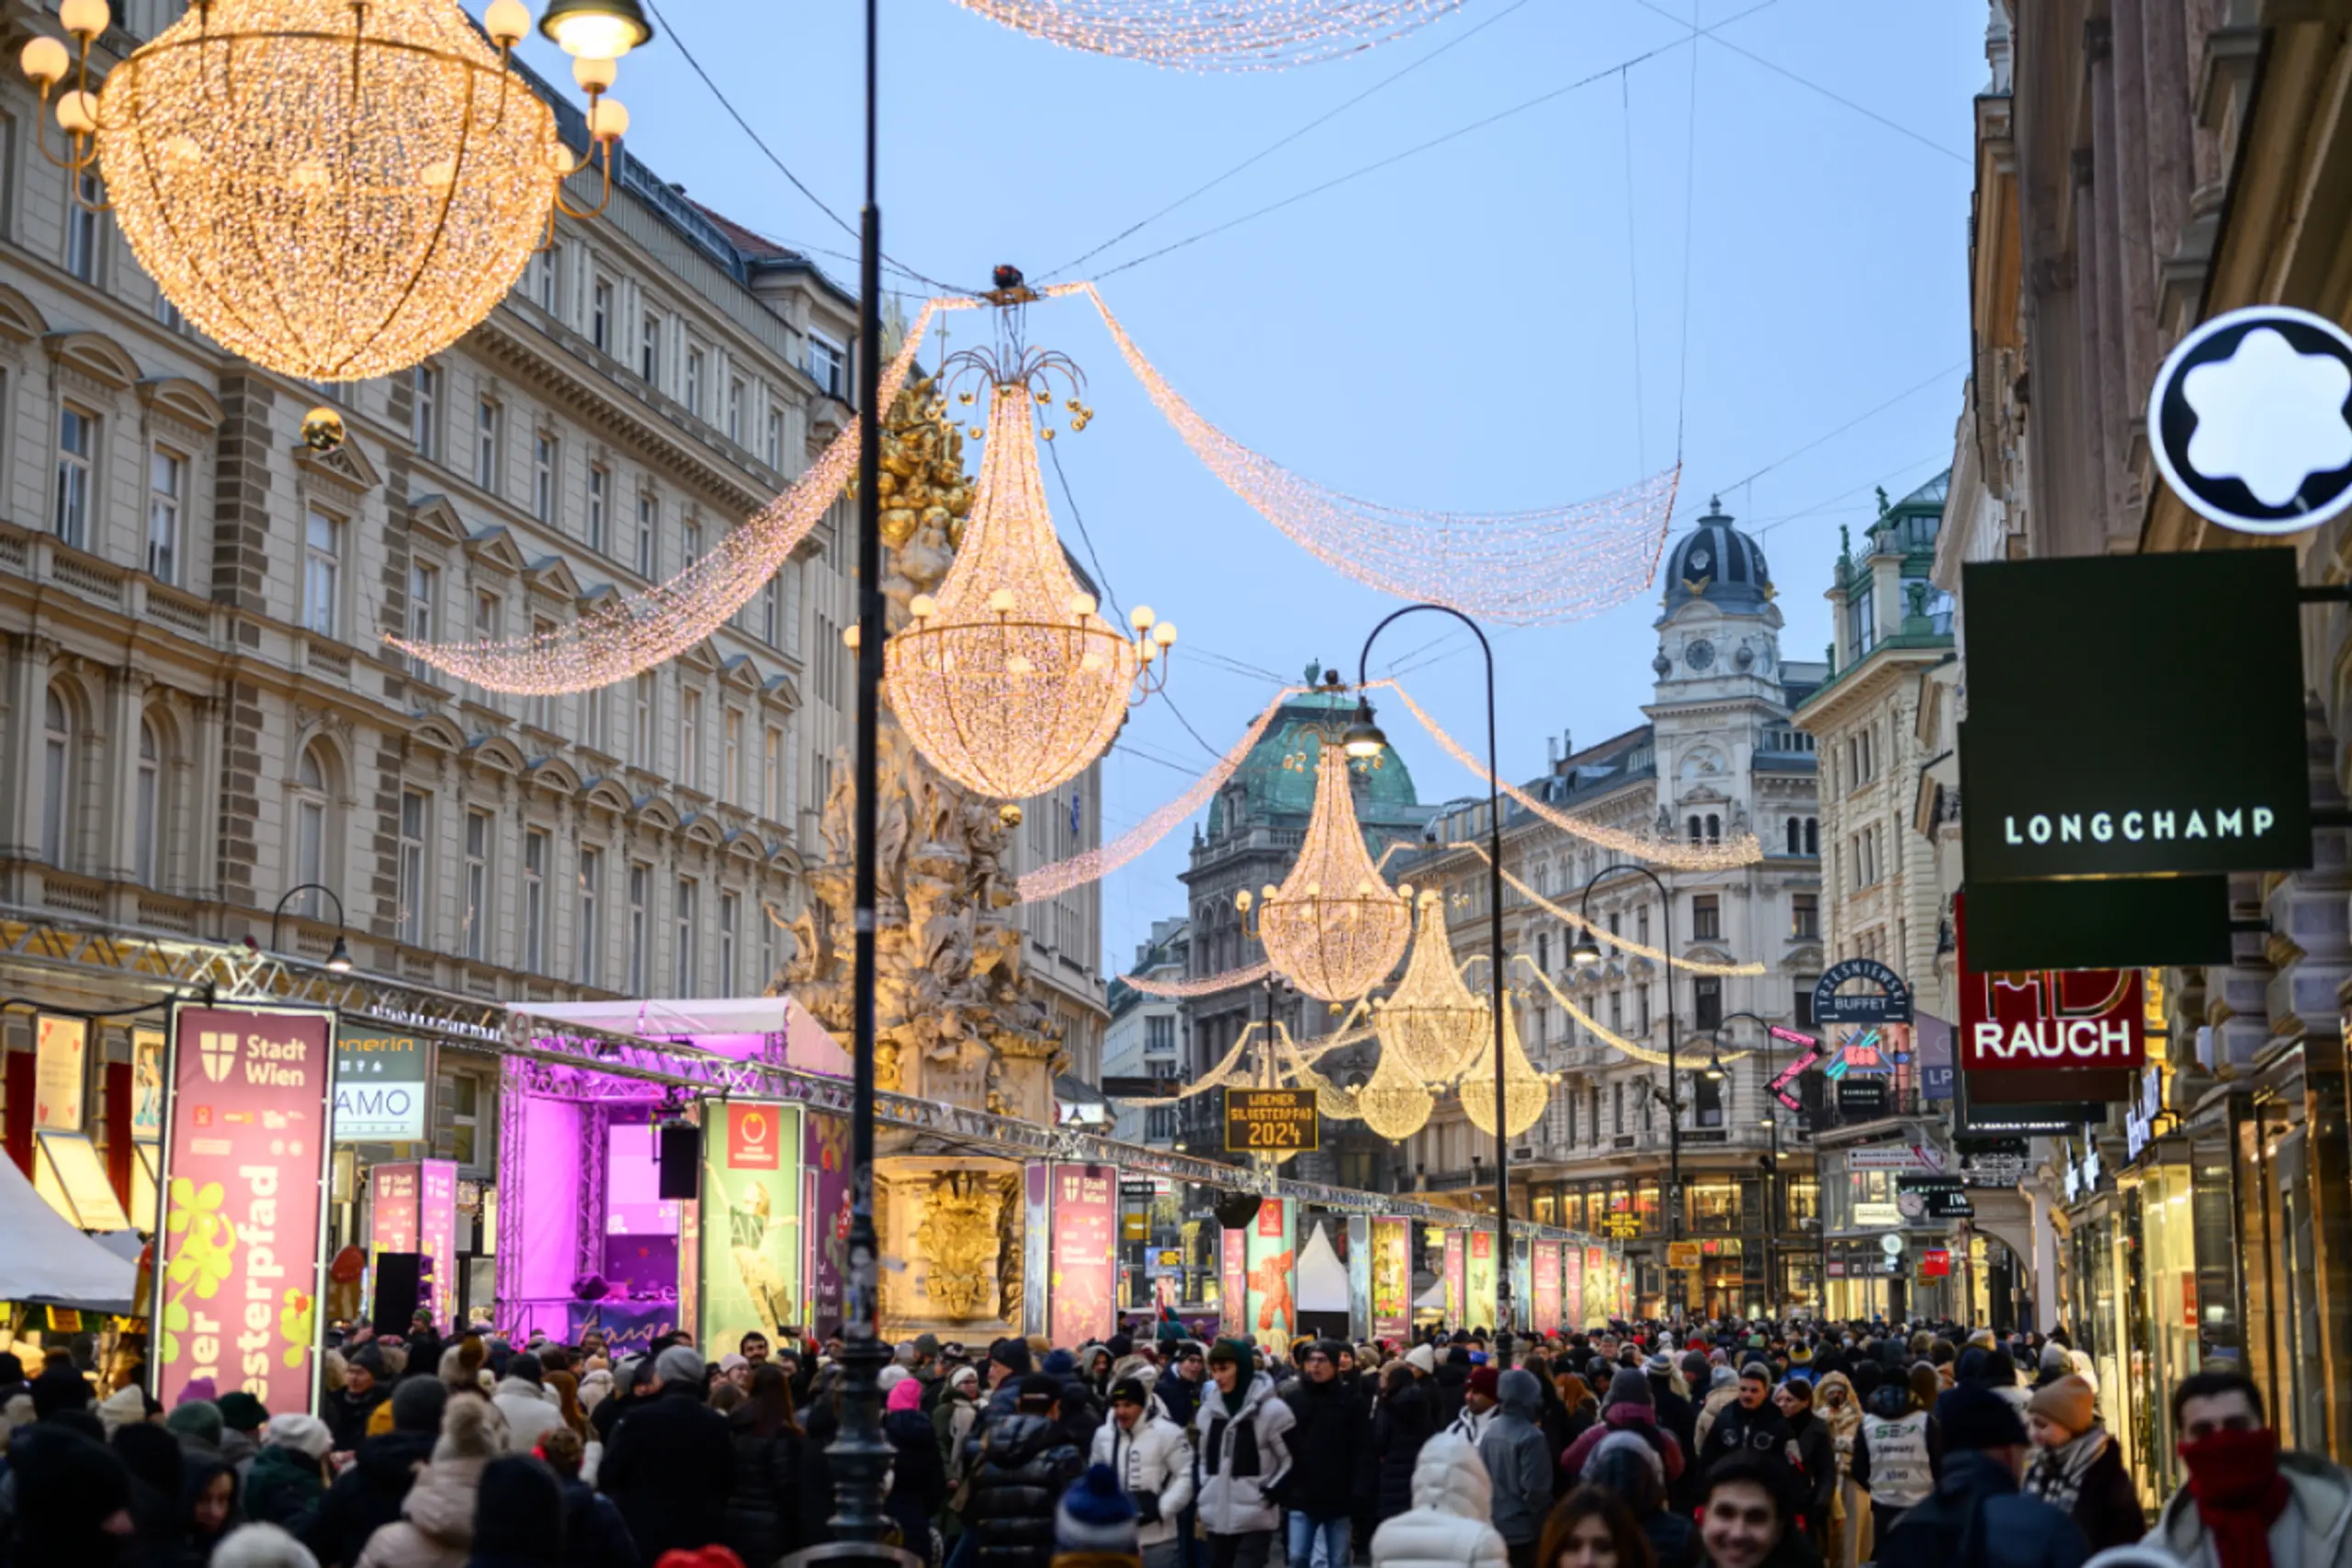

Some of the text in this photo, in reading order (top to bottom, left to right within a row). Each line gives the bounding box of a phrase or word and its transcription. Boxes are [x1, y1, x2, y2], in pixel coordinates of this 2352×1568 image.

[2005, 807, 2275, 844] LONGCHAMP
[1834, 998, 1887, 1010] BUFFET
[246, 1034, 307, 1061] Stadt
[1973, 1019, 2131, 1058] RAUCH
[245, 1060, 306, 1087] Wien
[1249, 1122, 1302, 1145] 2024
